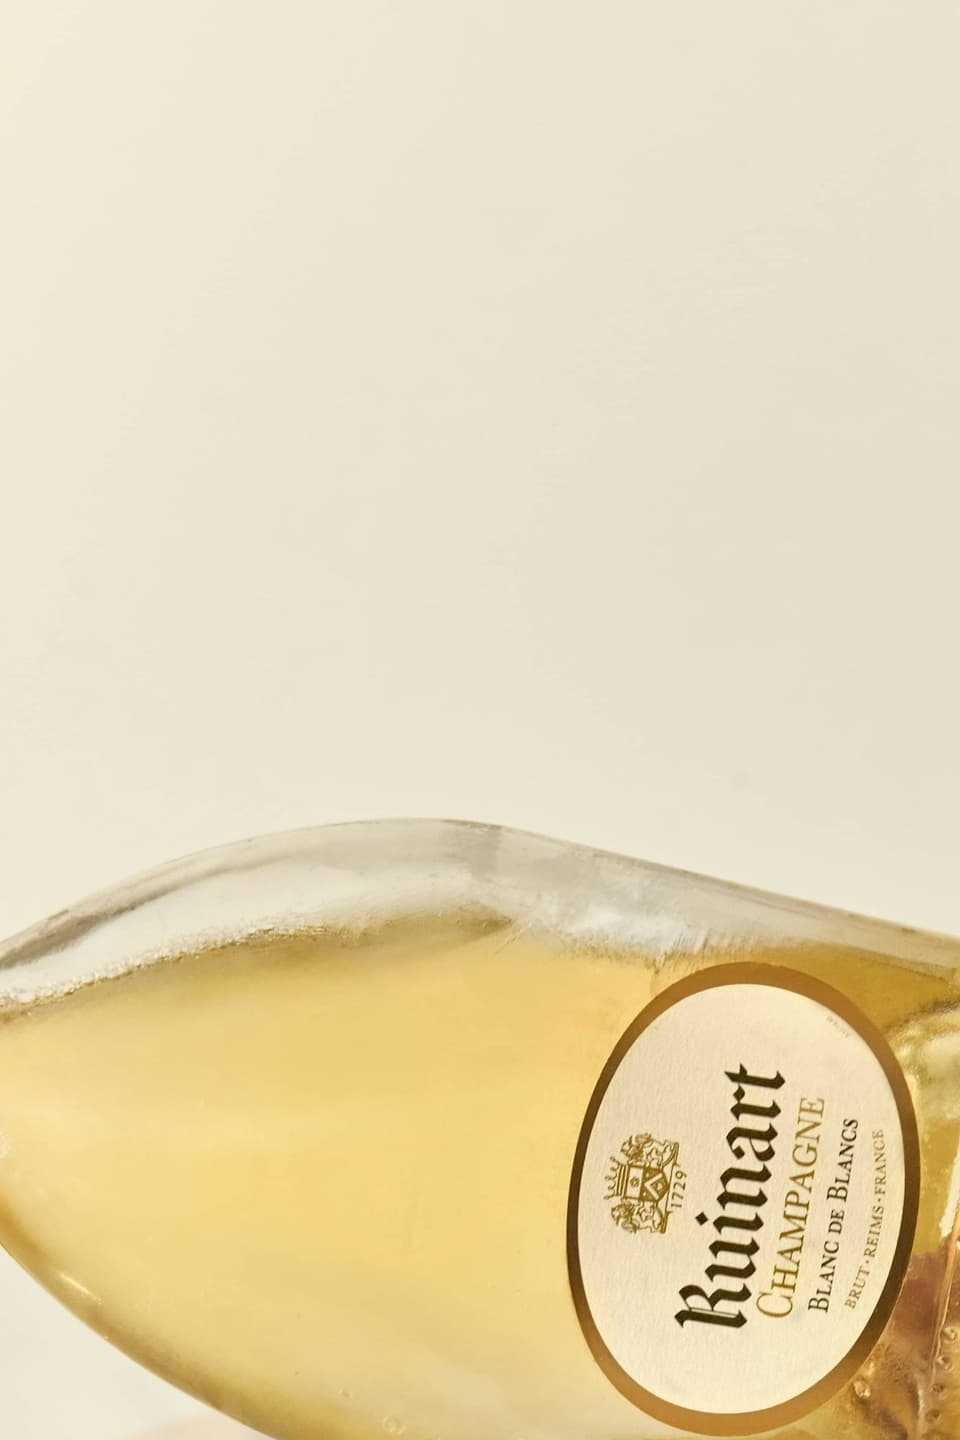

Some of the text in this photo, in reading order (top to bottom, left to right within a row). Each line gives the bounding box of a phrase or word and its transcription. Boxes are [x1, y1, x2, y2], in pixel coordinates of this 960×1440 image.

[670, 1169, 688, 1209] 1729
[673, 1062, 786, 1329] Ruinart
[756, 1097, 825, 1318] CHAMPAGNE
[807, 1240, 840, 1313] BLANC
[827, 1118, 859, 1202] BLANCS
